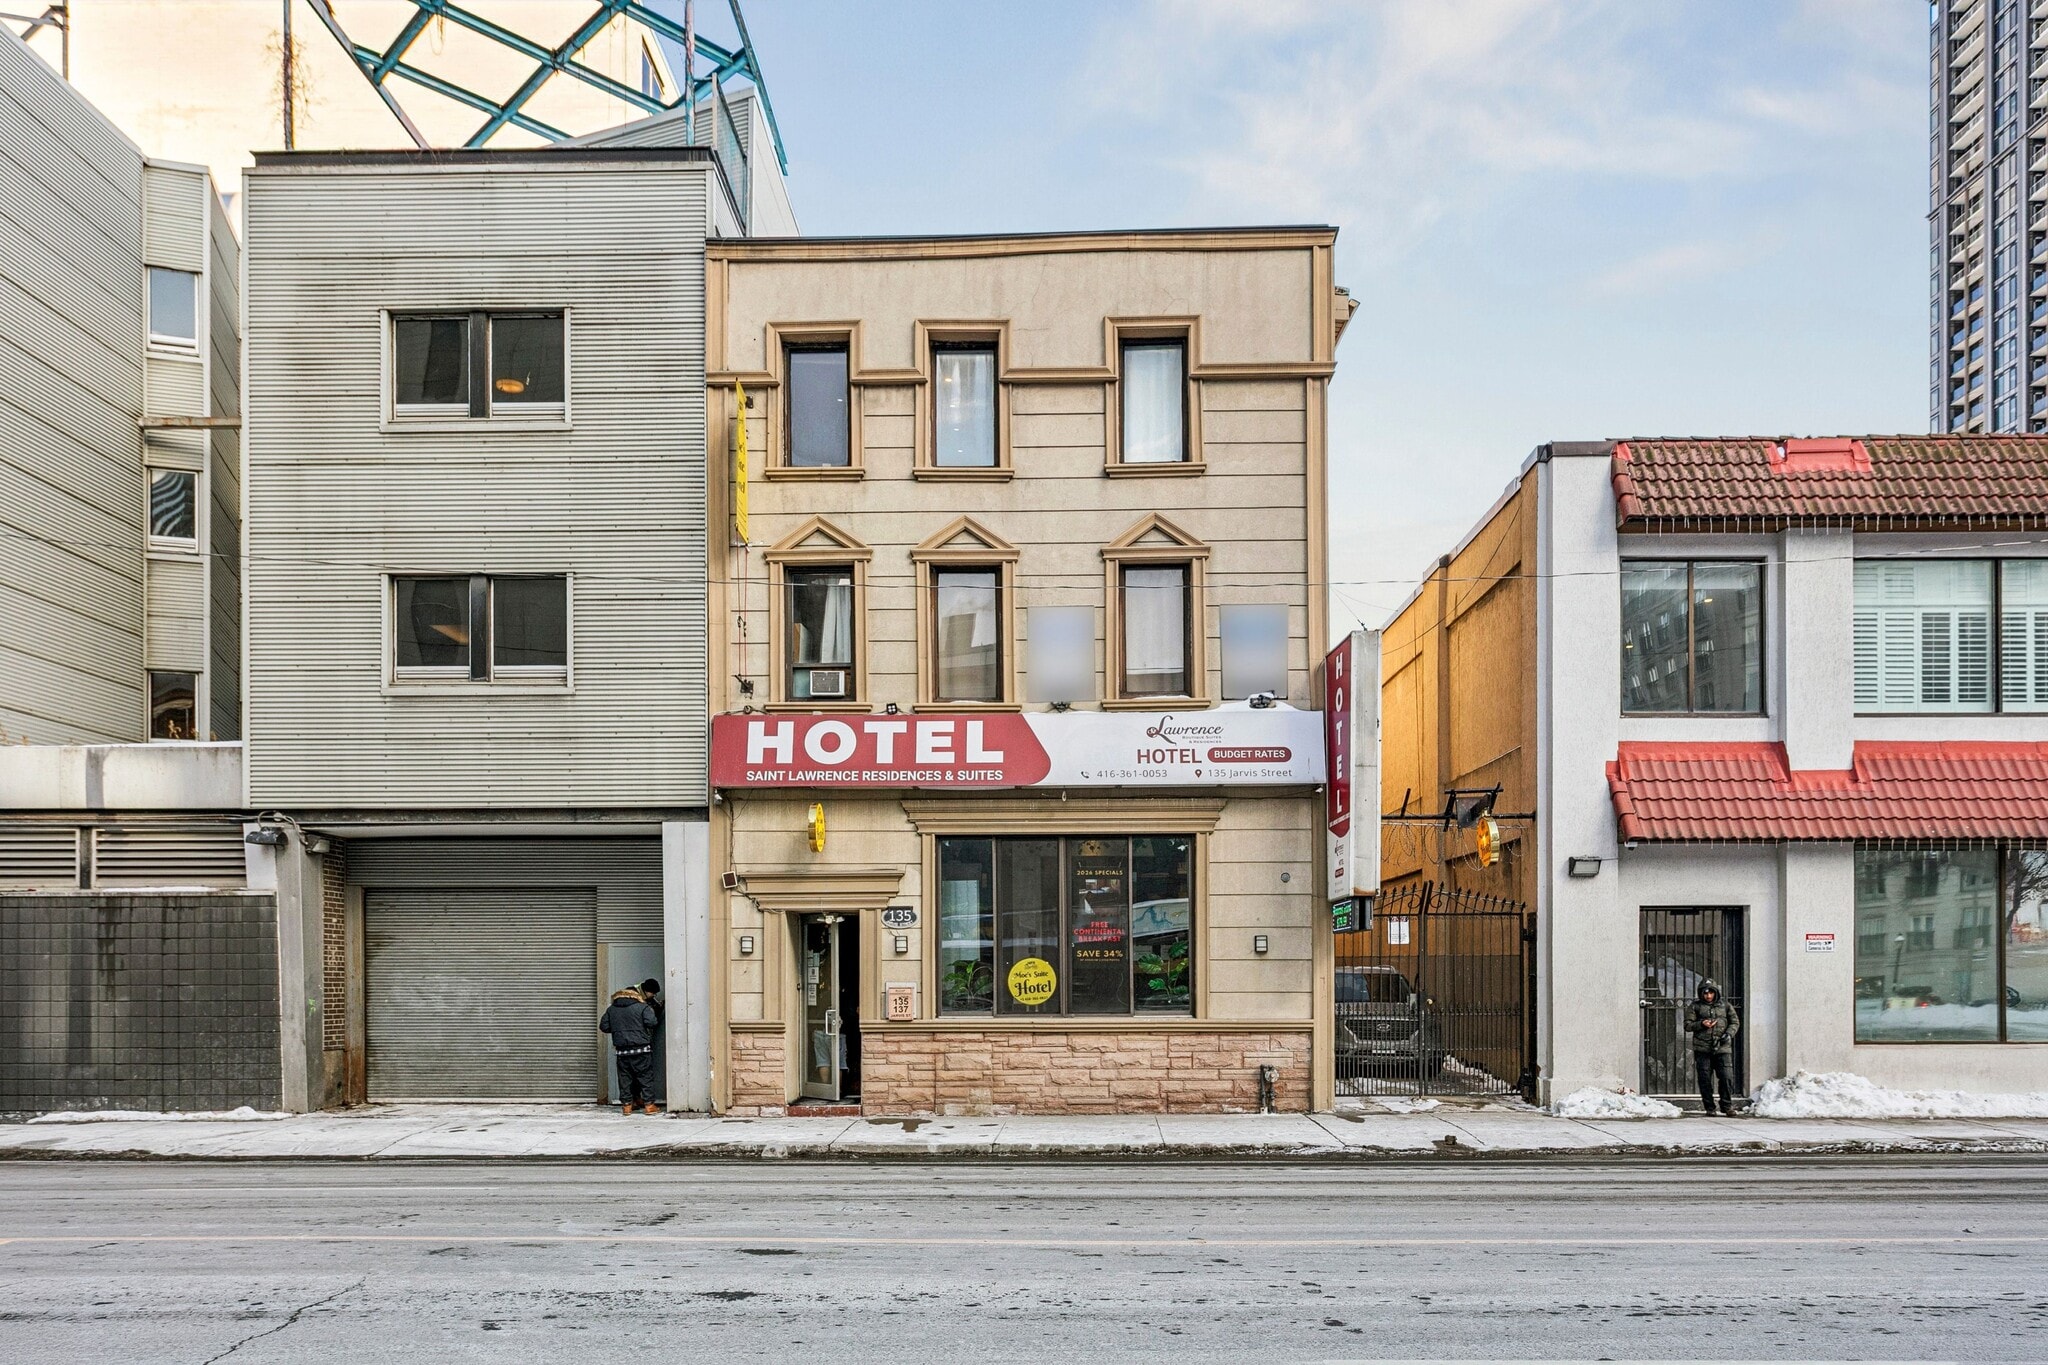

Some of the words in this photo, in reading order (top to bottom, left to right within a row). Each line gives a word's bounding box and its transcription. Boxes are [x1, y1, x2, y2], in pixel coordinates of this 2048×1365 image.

[1147, 715, 1224, 745] Lawrence
[1335, 651, 1343, 814] HOTEL
[746, 720, 1004, 765] HOTEL
[1137, 749, 1202, 764] HOTEL
[1214, 750, 1252, 759] BUDGET
[1254, 749, 1285, 759] RATES
[746, 770, 785, 781] SAINT
[788, 770, 859, 781] LAWRENCE
[862, 770, 942, 781] RESIDENCES
[945, 770, 954, 781] &
[957, 769, 1003, 781] SUITES
[1096, 769, 1168, 778] 416-361-0053
[1208, 769, 1226, 777] 135
[1228, 769, 1258, 779] Jarvis
[1261, 768, 1293, 777] Street
[889, 910, 912, 921] 135
[1014, 979, 1051, 997] Hotel
[893, 997, 909, 1005] 135
